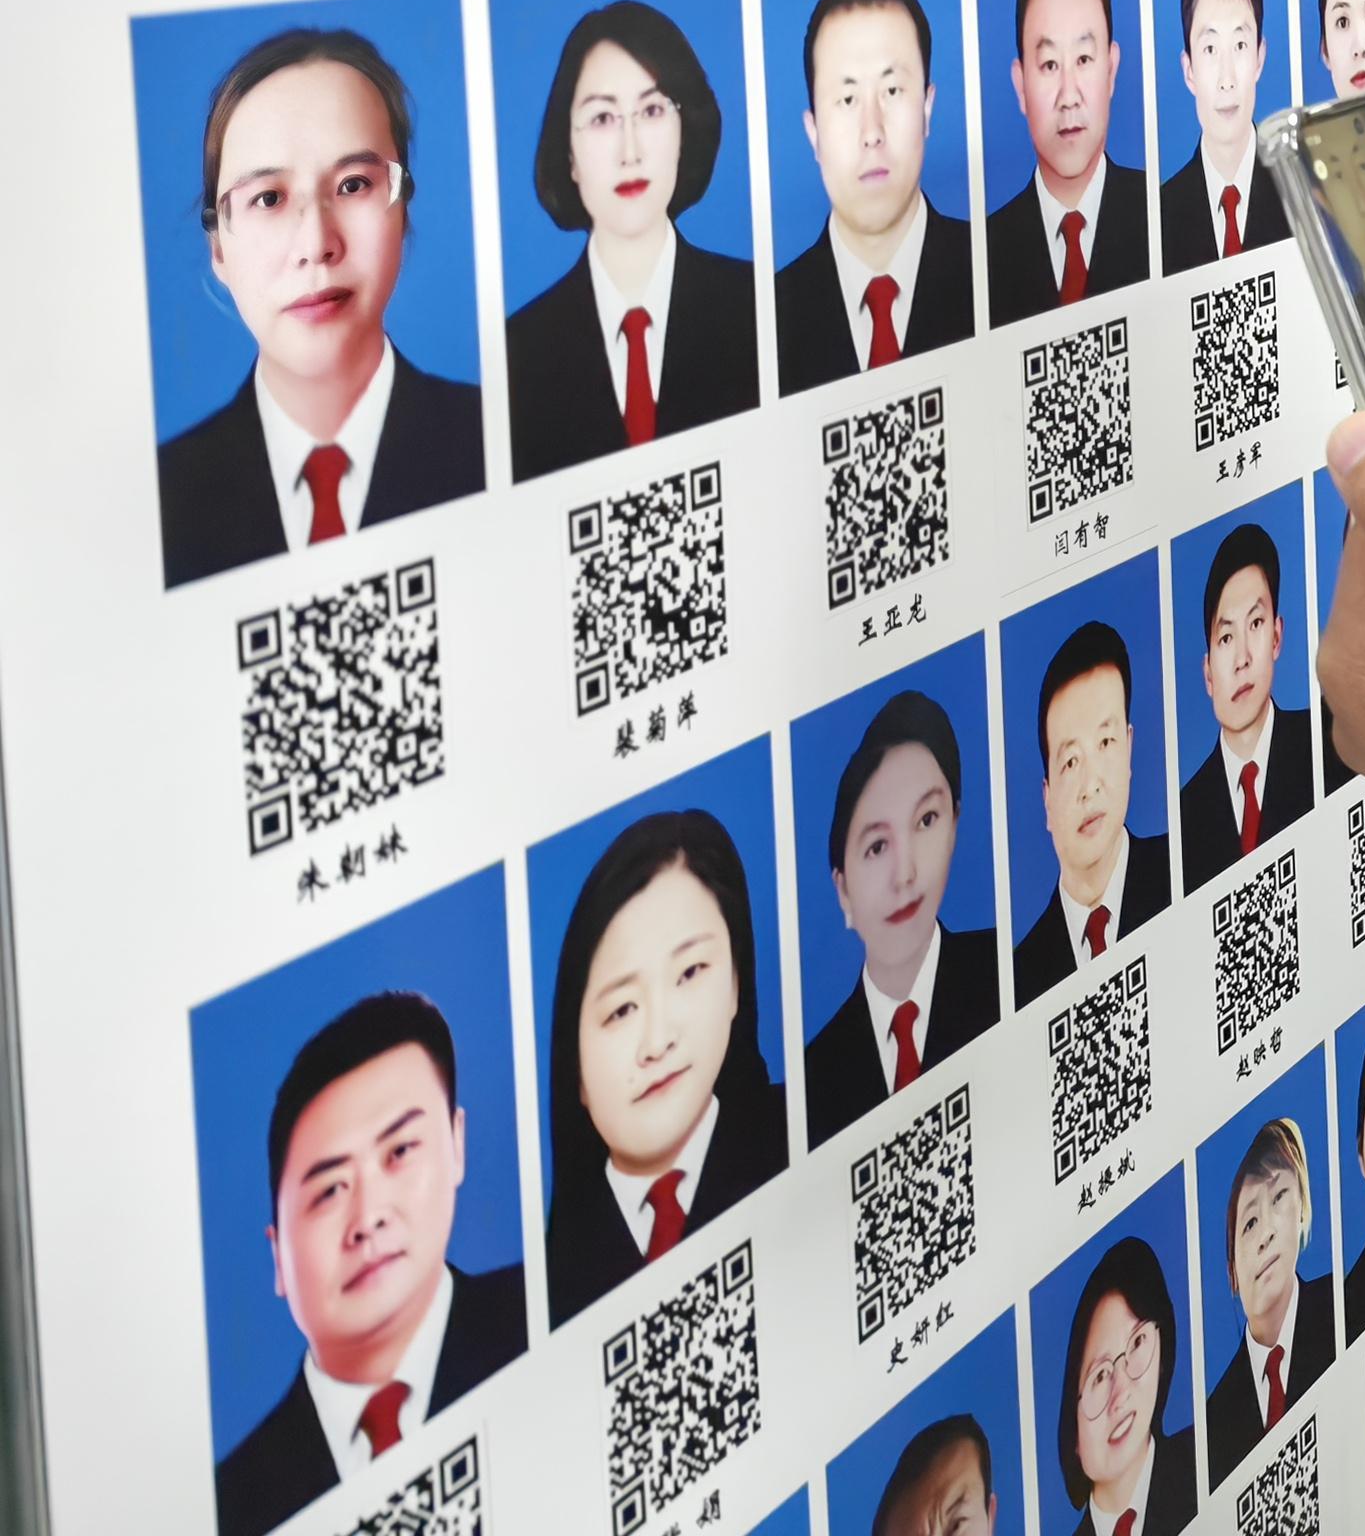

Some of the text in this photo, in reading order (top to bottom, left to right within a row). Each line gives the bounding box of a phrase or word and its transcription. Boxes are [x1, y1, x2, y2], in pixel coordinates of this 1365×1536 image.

[1055, 512, 1109, 556] 闫有智
[858, 593, 927, 647] 王亚龙
